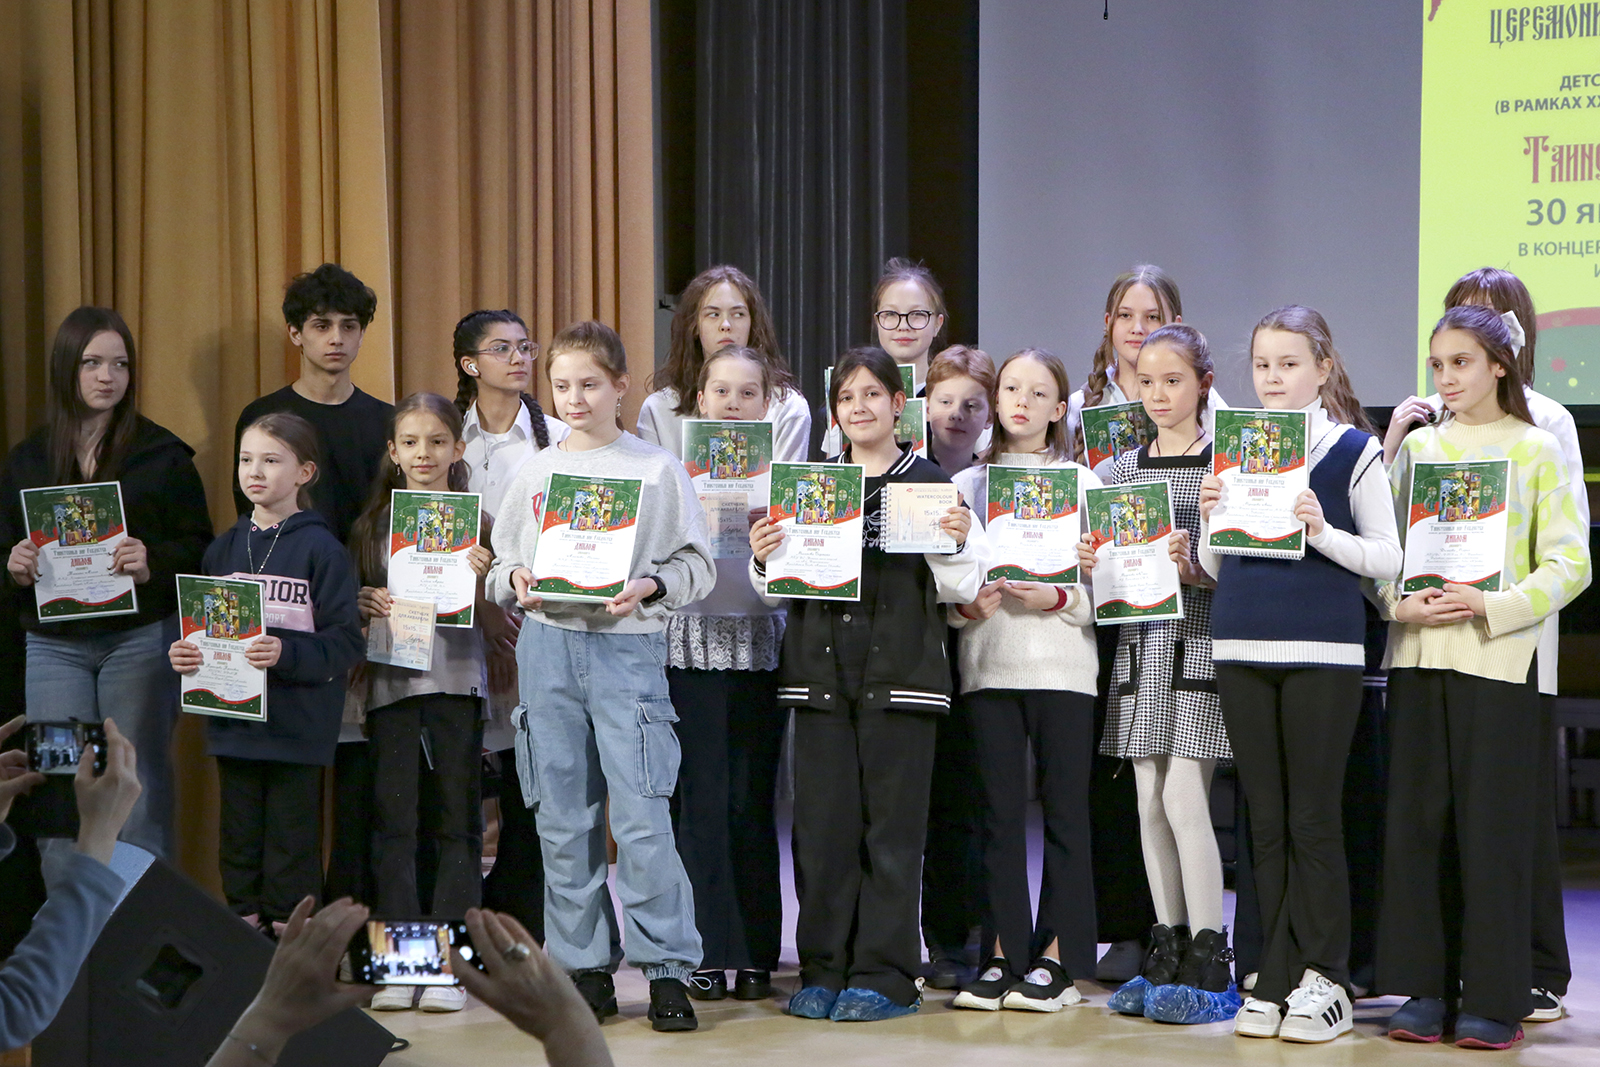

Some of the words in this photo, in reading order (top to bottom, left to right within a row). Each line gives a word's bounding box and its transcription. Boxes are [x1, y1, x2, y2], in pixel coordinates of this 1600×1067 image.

[1514, 96, 1582, 112] РАМКАХ
[1526, 197, 1567, 226] 30
[1518, 242, 1528, 257] В
